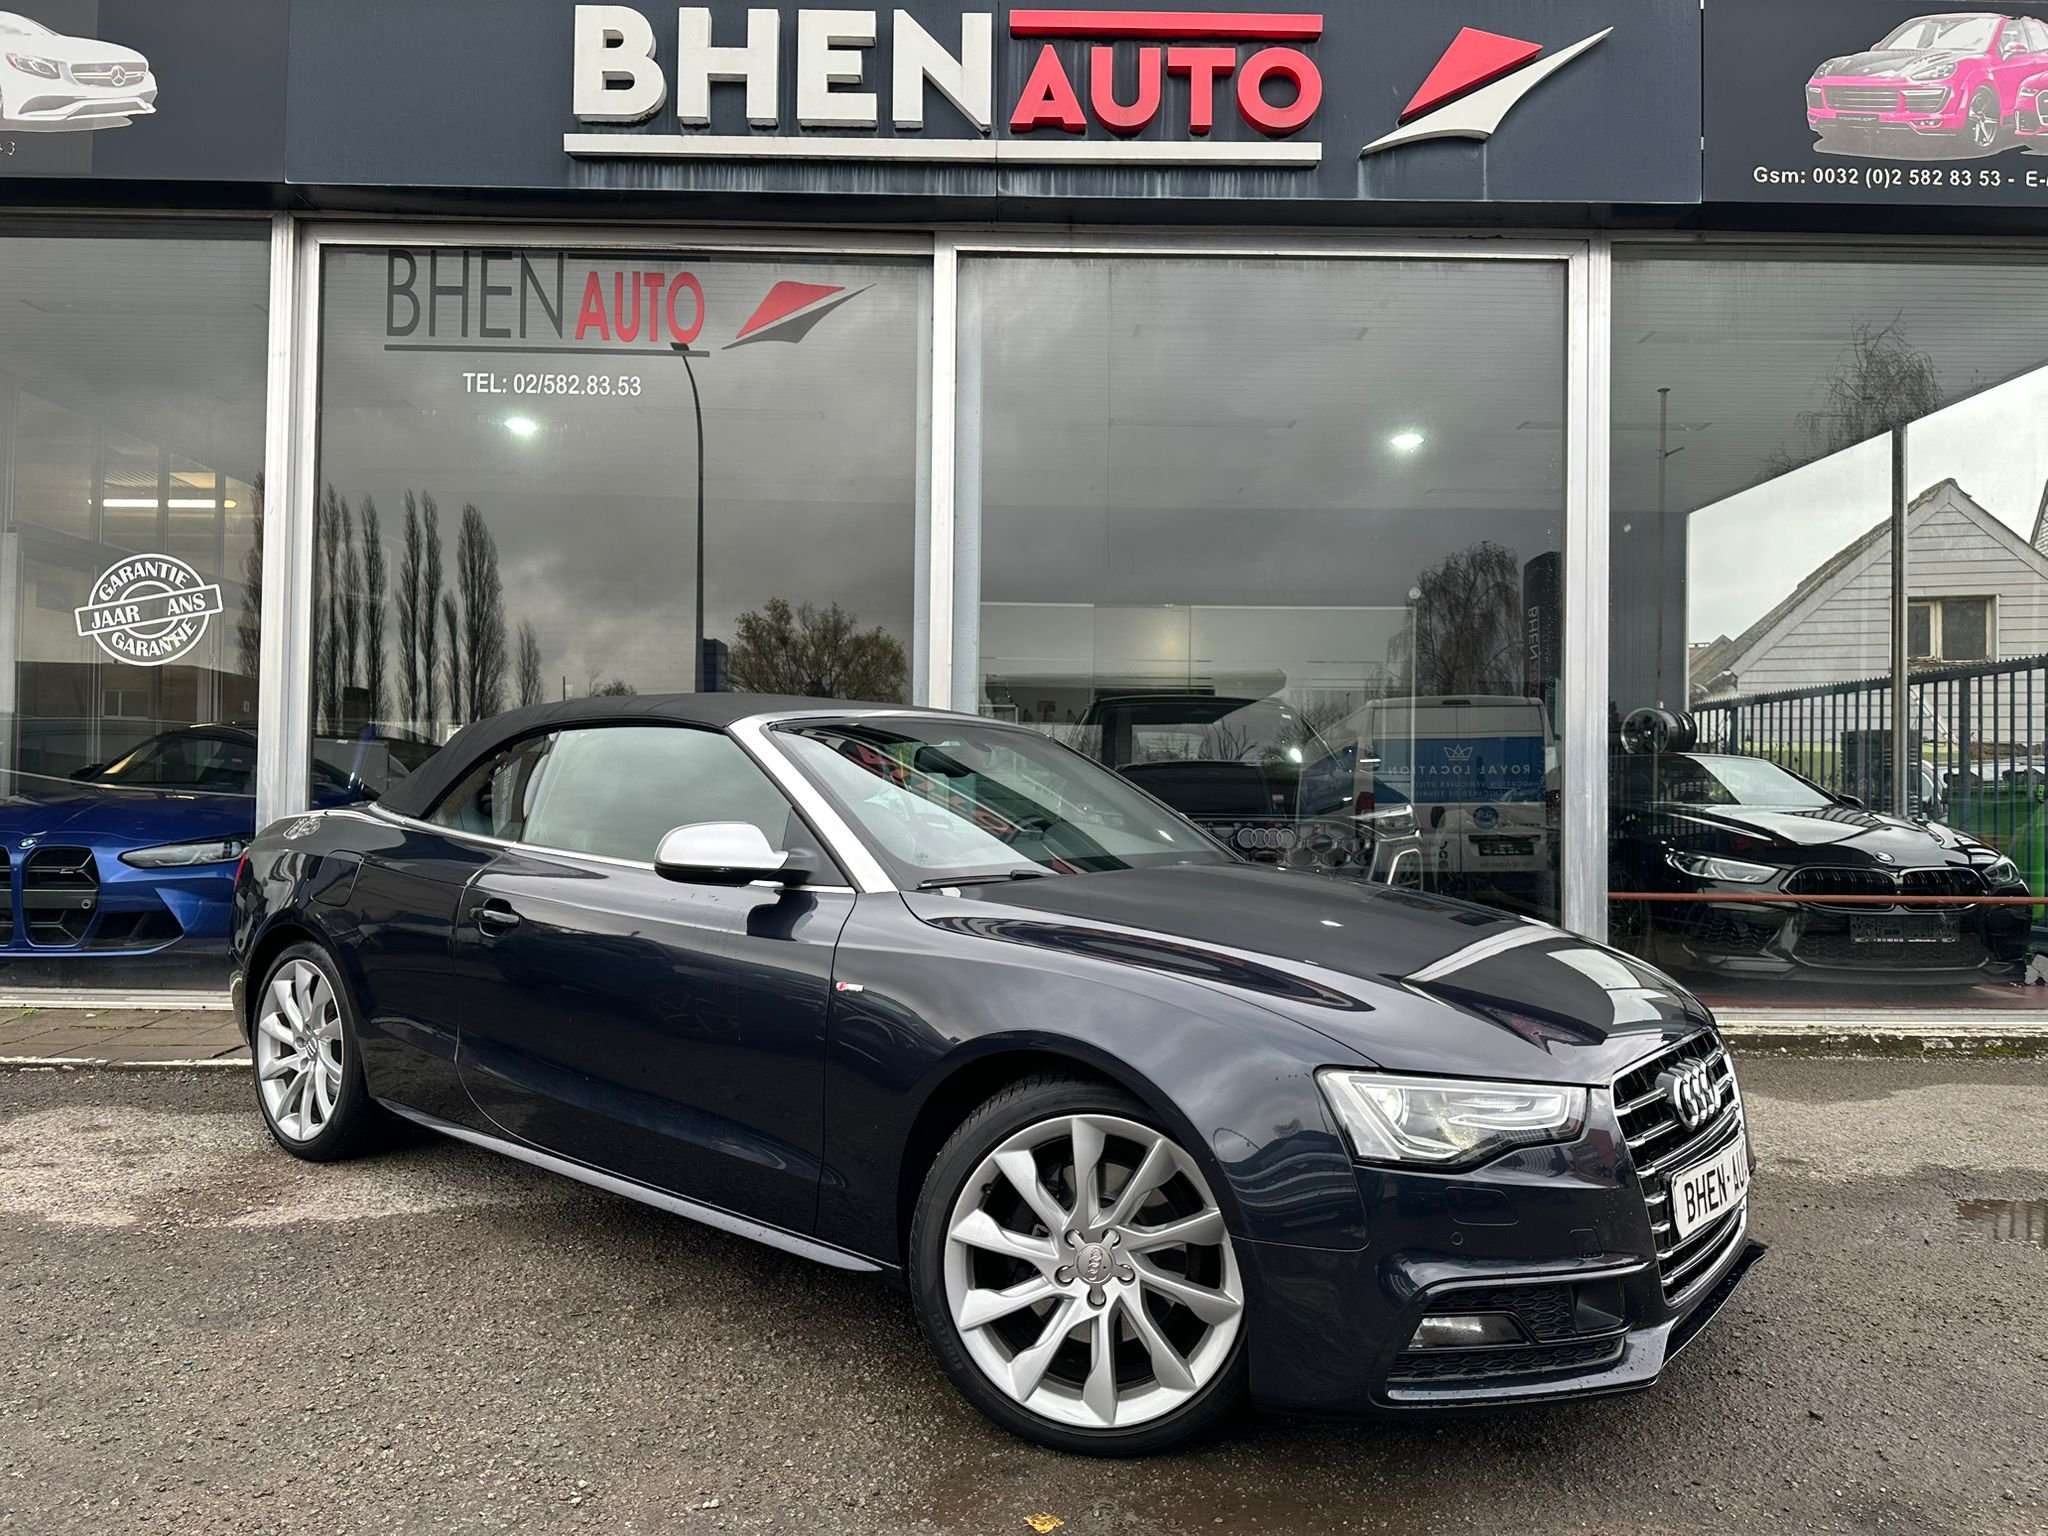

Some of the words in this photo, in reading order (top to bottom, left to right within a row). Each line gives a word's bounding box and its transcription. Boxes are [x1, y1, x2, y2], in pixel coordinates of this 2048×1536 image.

[573, 4, 992, 134] BHEN
[1009, 44, 1322, 137] AUTO
[1753, 166, 1806, 185] Gsm:
[1812, 168, 1858, 185] 0032
[1865, 167, 1902, 189] (0)2
[1908, 169, 1943, 186] 582
[1950, 169, 1972, 187] 83
[1978, 170, 2001, 187] 53
[2025, 170, 2048, 188] E-
[386, 250, 564, 339] BHEN
[575, 271, 705, 344] AUTO
[463, 372, 507, 393] TEL:
[513, 374, 641, 396] 02/582.83.53
[100, 561, 190, 601] GARANTIE
[92, 605, 141, 629] JAAR
[167, 593, 207, 616] ANS
[111, 618, 198, 657] GARANTIE
[1684, 1148, 1748, 1223] BHEN-AU
